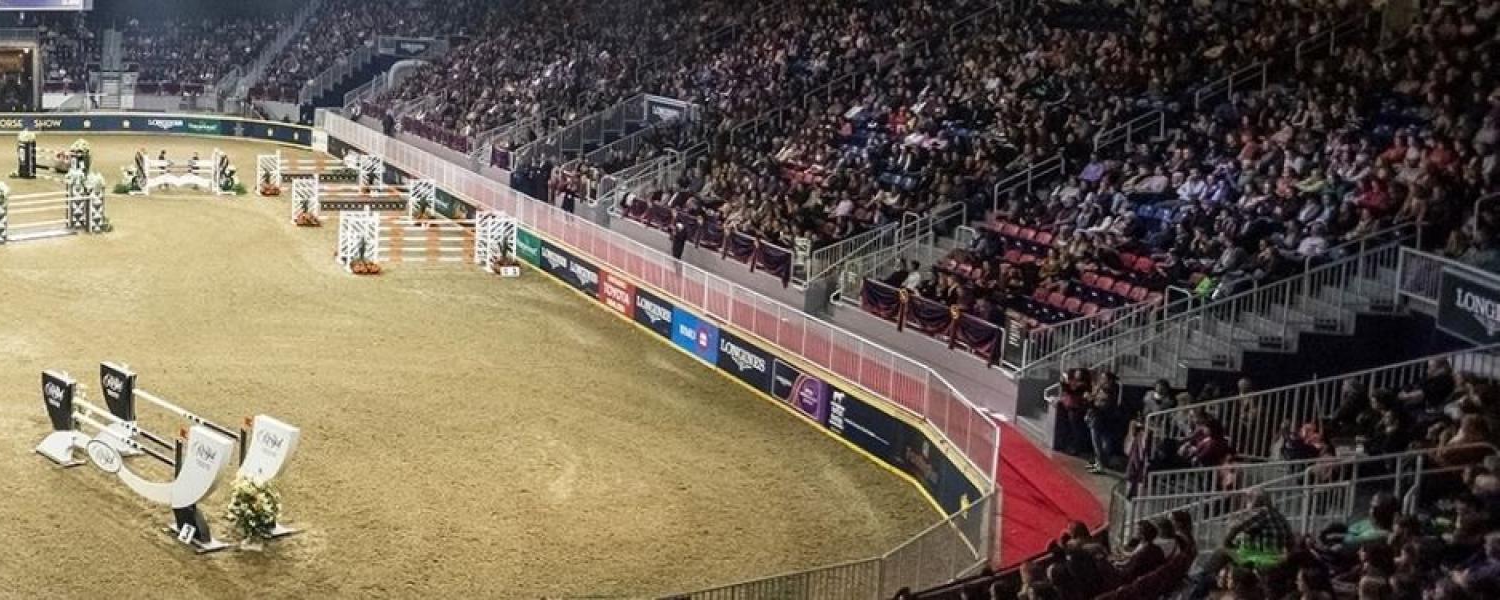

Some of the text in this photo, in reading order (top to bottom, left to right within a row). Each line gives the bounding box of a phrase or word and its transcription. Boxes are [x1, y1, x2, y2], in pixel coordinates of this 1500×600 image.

[603, 281, 629, 305] TOYOTA
[636, 295, 671, 323] LONGINES
[720, 338, 766, 372] LONGINES
